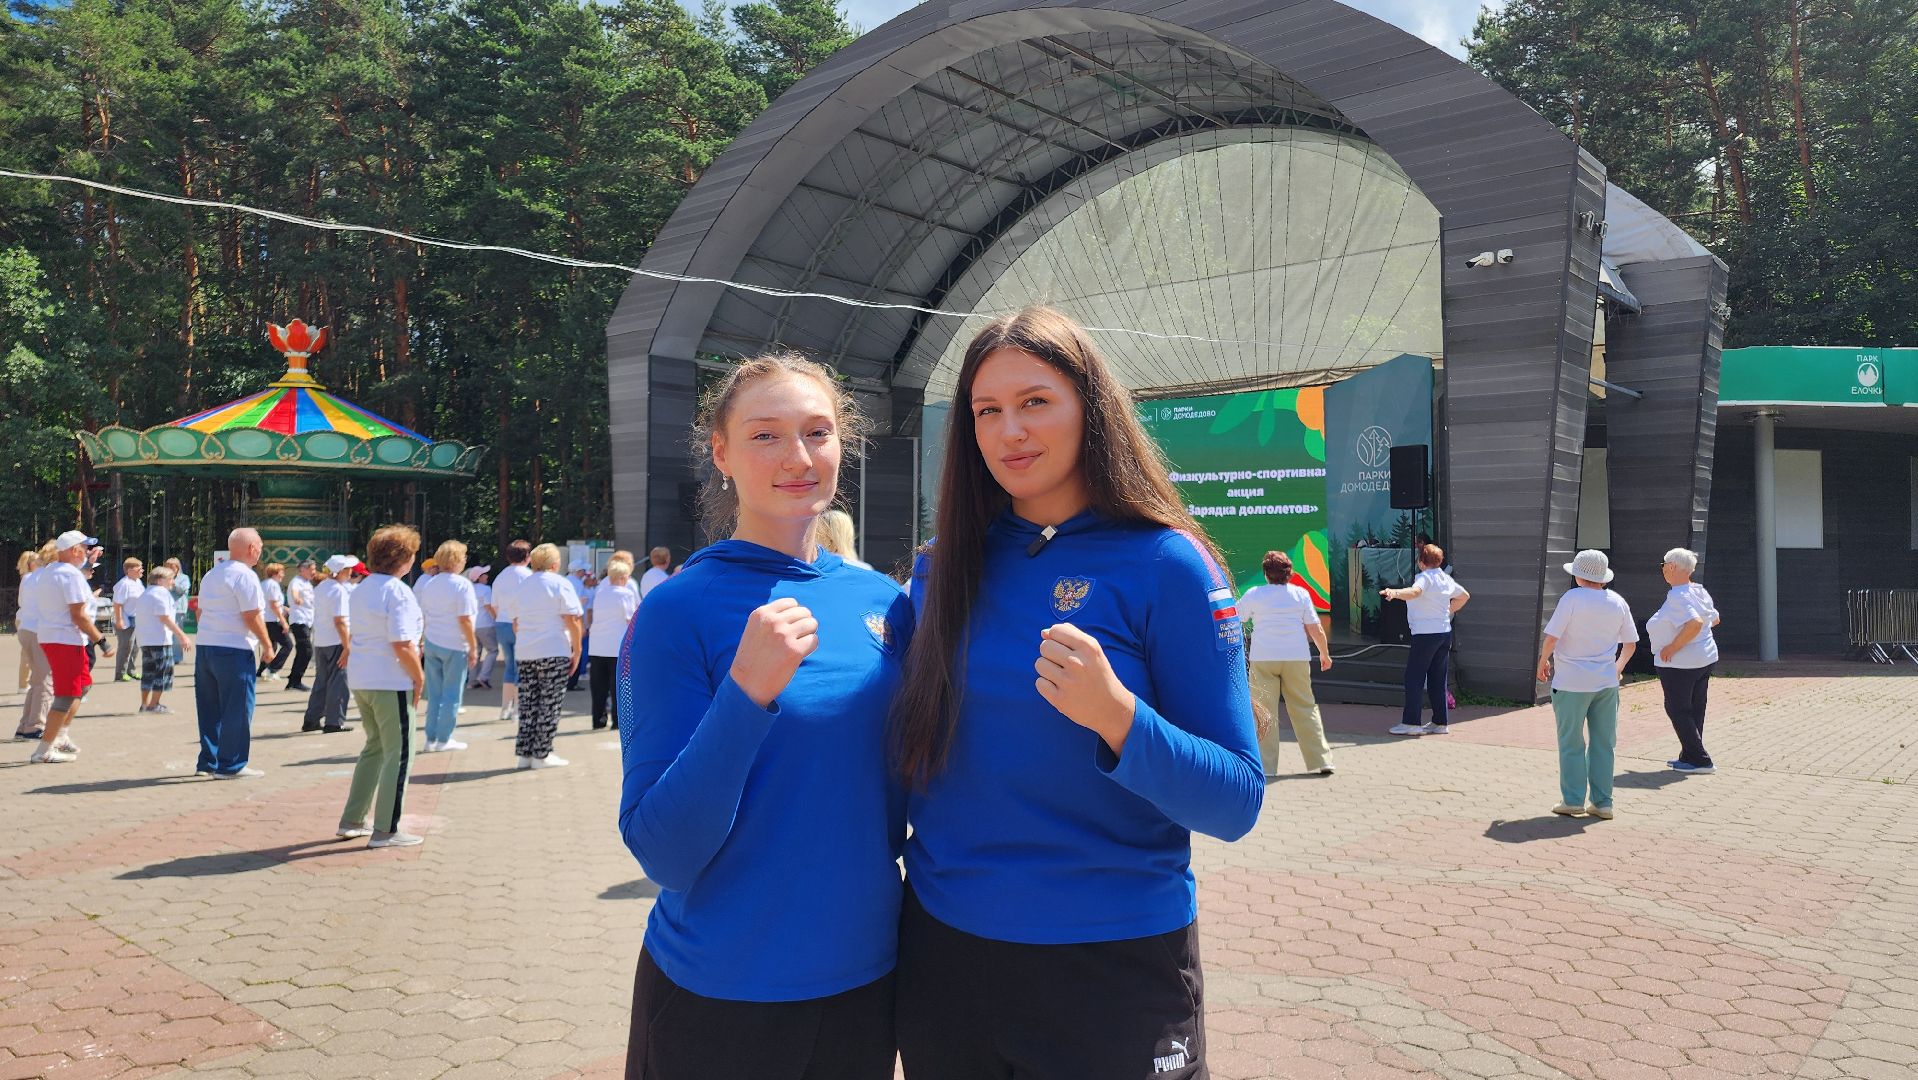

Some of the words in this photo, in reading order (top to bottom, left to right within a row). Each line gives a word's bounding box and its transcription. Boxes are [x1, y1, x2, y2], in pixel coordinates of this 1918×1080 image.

[1856, 354, 1879, 363] ПАРК
[1851, 386, 1884, 395] ЕЛОЧКИ
[1173, 410, 1216, 420] ДОМОДЕДОВО
[1358, 470, 1391, 480] ПАРКИ
[1340, 481, 1391, 493] ДОМОДЕД
[1227, 488, 1264, 499] акция
[1238, 504, 1319, 517] долголетов»
[1153, 1052, 1185, 1074] PUMA
